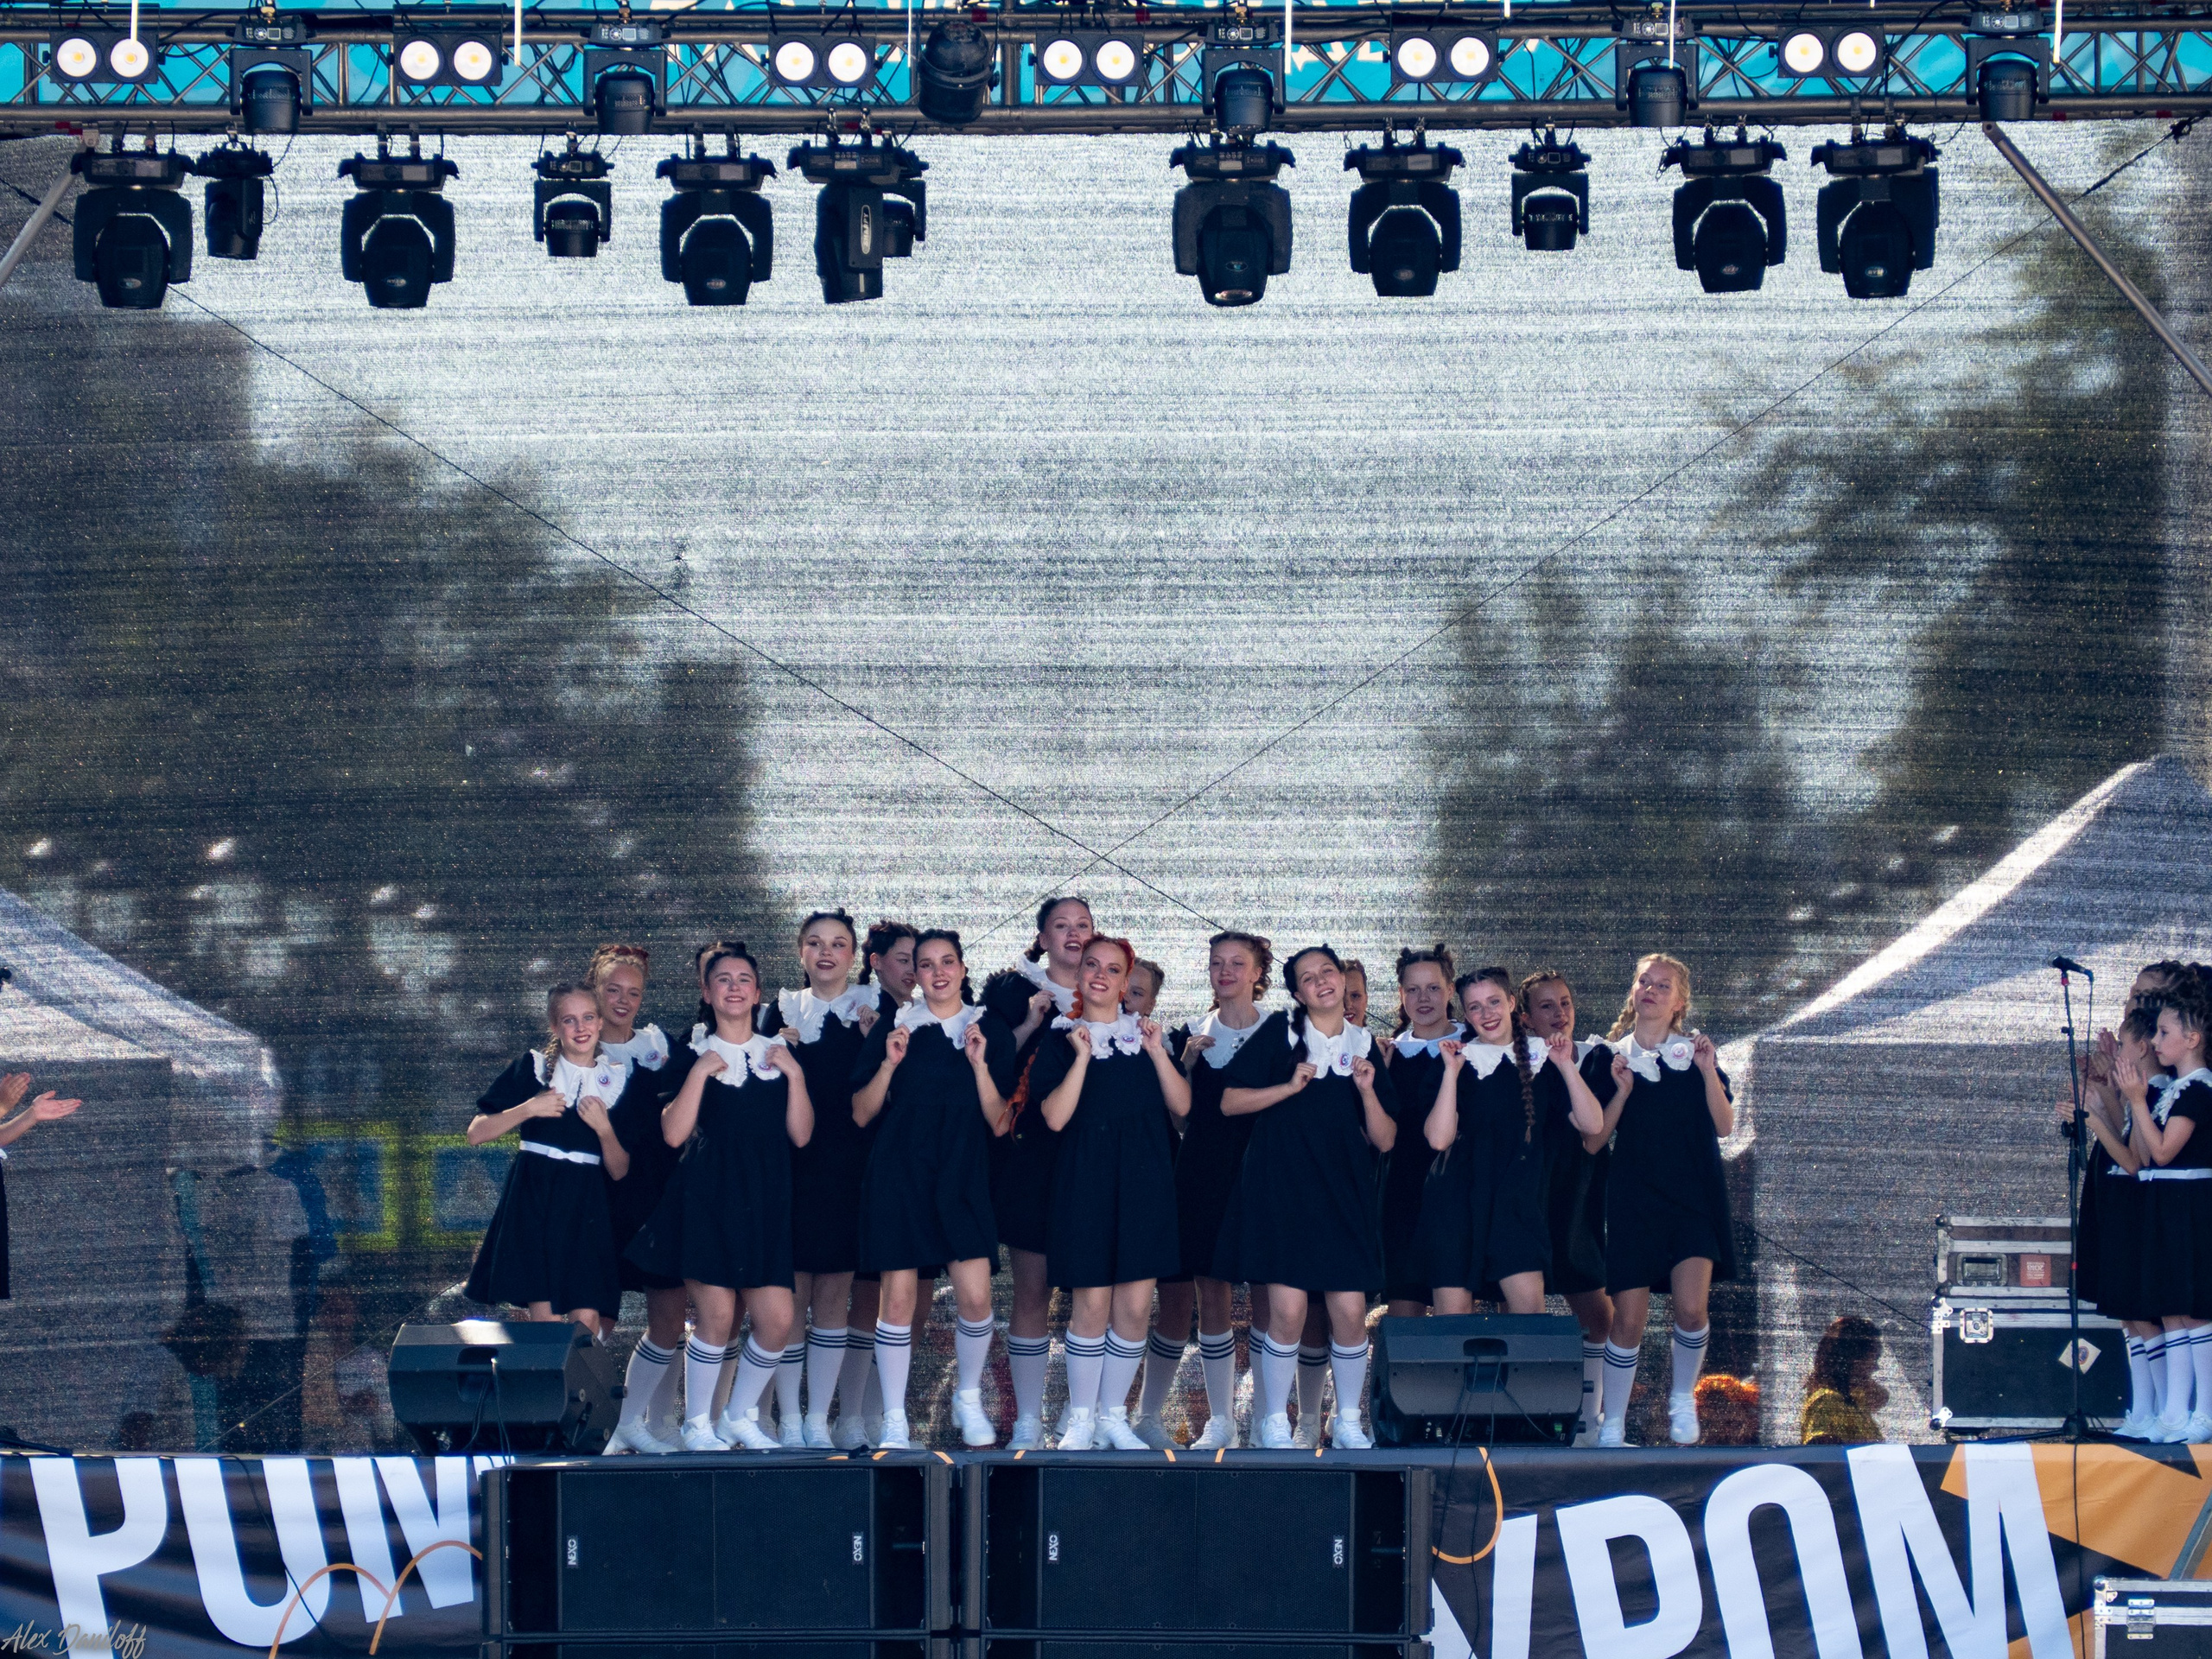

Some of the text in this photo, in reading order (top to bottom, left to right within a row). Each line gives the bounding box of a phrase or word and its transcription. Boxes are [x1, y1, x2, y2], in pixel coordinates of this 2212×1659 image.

[567, 1538, 577, 1566] NEXO
[852, 1535, 863, 1561] NEXO
[1048, 1535, 1059, 1561] NEXO
[1332, 1538, 1344, 1566] NEXO
